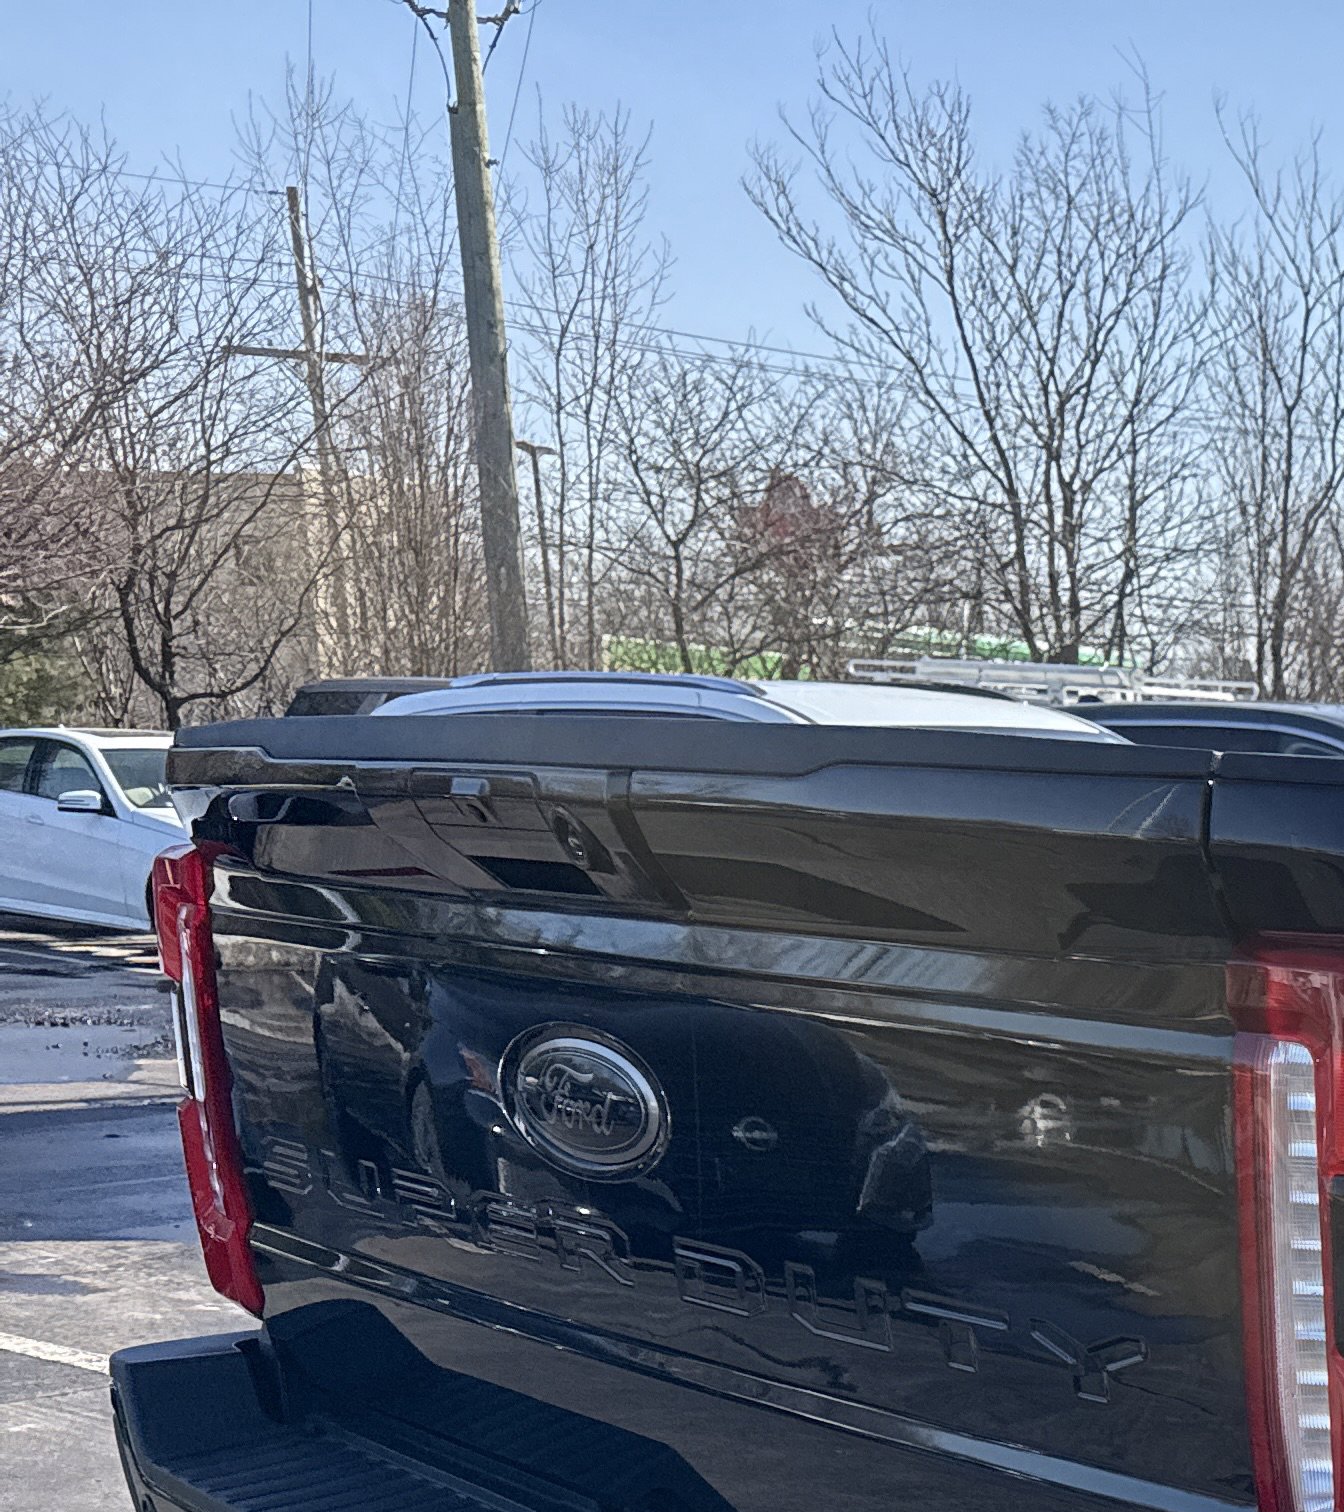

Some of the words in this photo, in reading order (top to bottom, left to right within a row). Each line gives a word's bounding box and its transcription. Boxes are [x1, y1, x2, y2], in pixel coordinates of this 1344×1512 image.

[540, 1062, 614, 1137] Ford
[262, 1135, 635, 1287] SUPER
[673, 1235, 1150, 1404] DUTY
